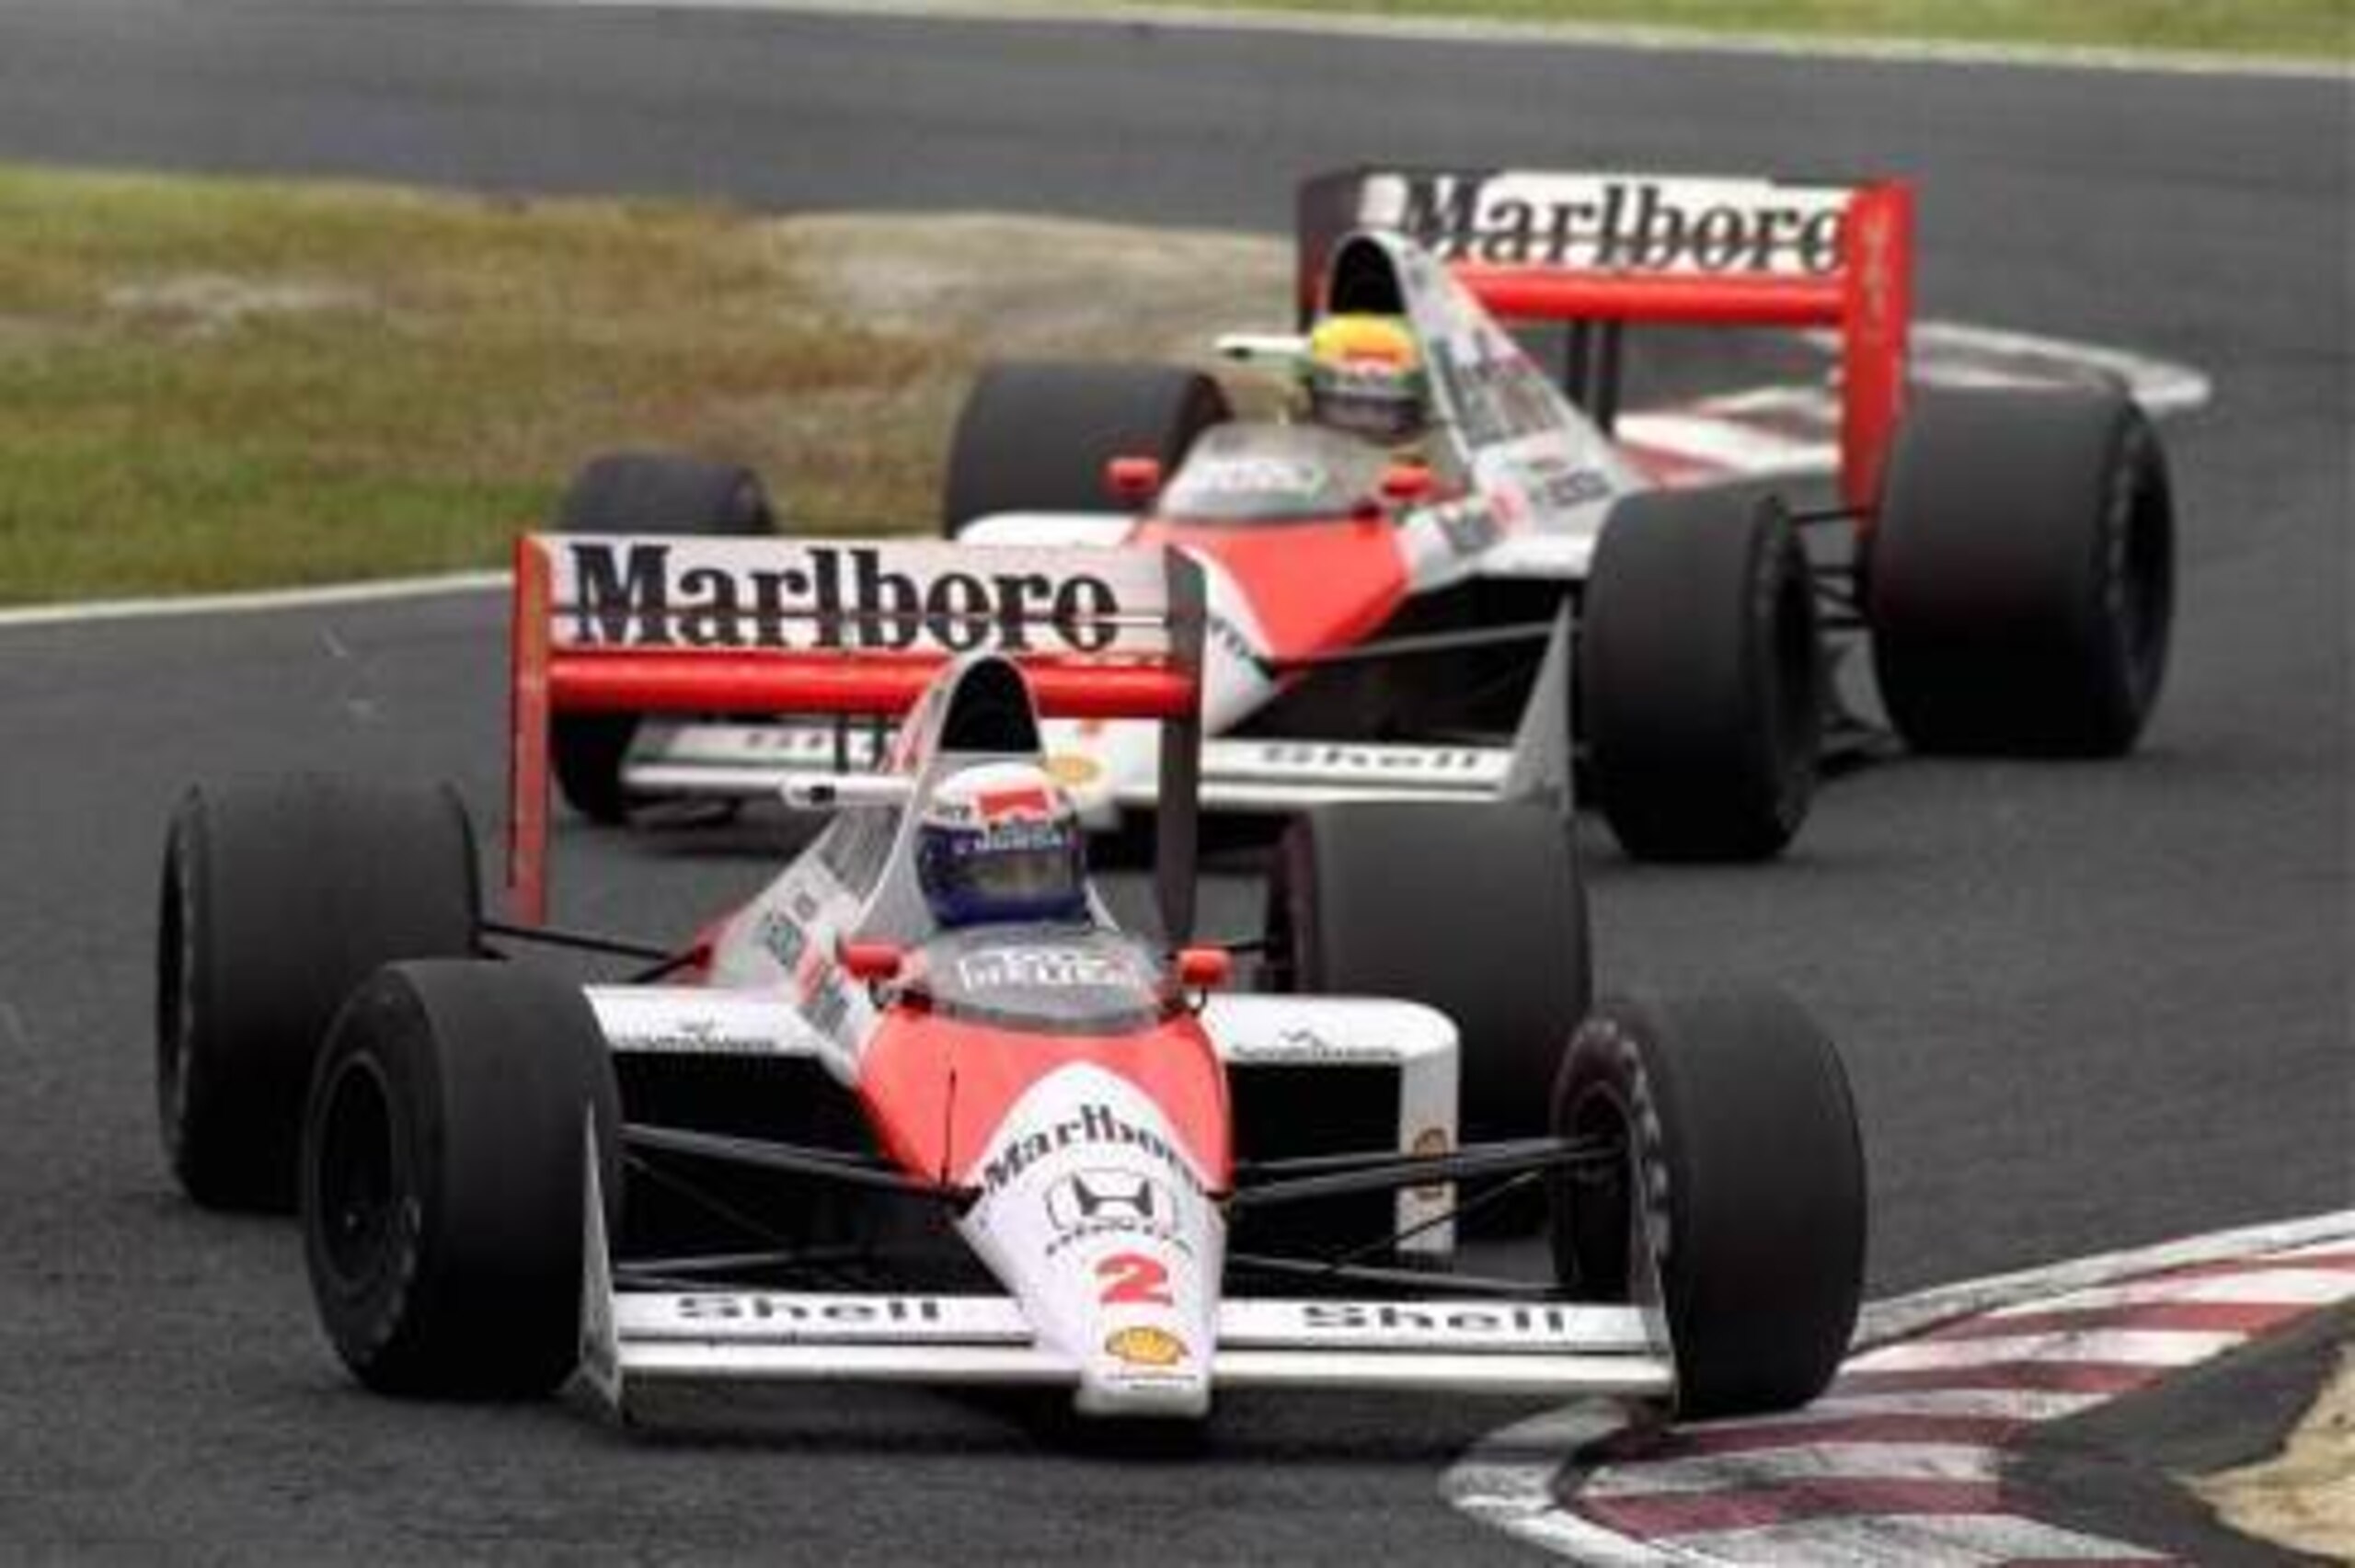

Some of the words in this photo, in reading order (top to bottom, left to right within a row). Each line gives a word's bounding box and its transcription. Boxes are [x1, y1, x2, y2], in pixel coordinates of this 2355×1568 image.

[1405, 175, 1849, 275] Marlboro
[570, 543, 1120, 654] Marlboro
[1095, 1249, 1175, 1307] 2
[674, 1295, 941, 1322] Shell
[1301, 1303, 1567, 1334] Shell
